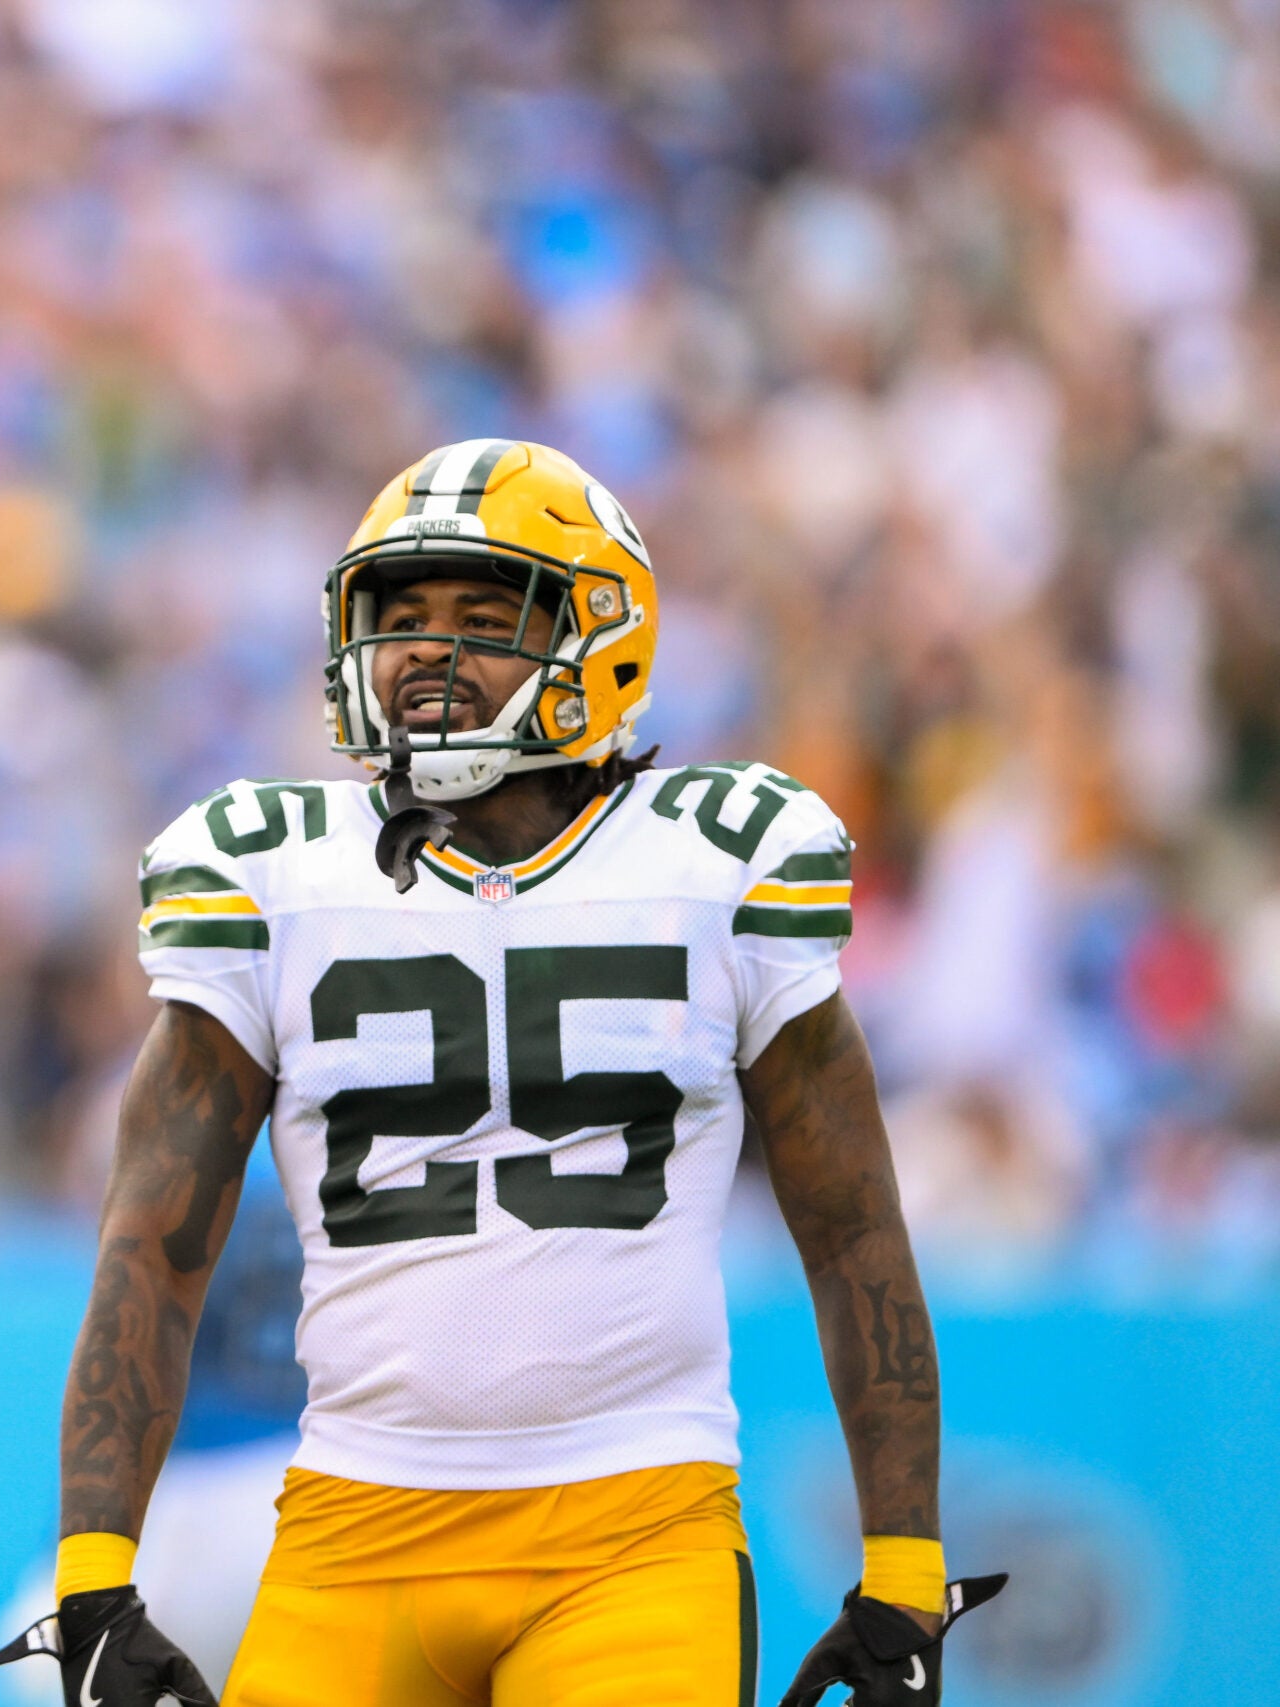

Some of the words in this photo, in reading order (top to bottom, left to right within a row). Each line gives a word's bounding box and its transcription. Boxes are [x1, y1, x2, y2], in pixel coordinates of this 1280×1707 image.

[407, 519, 460, 535] PACKERS
[480, 883, 510, 900] NFL
[310, 945, 689, 1248] 25
